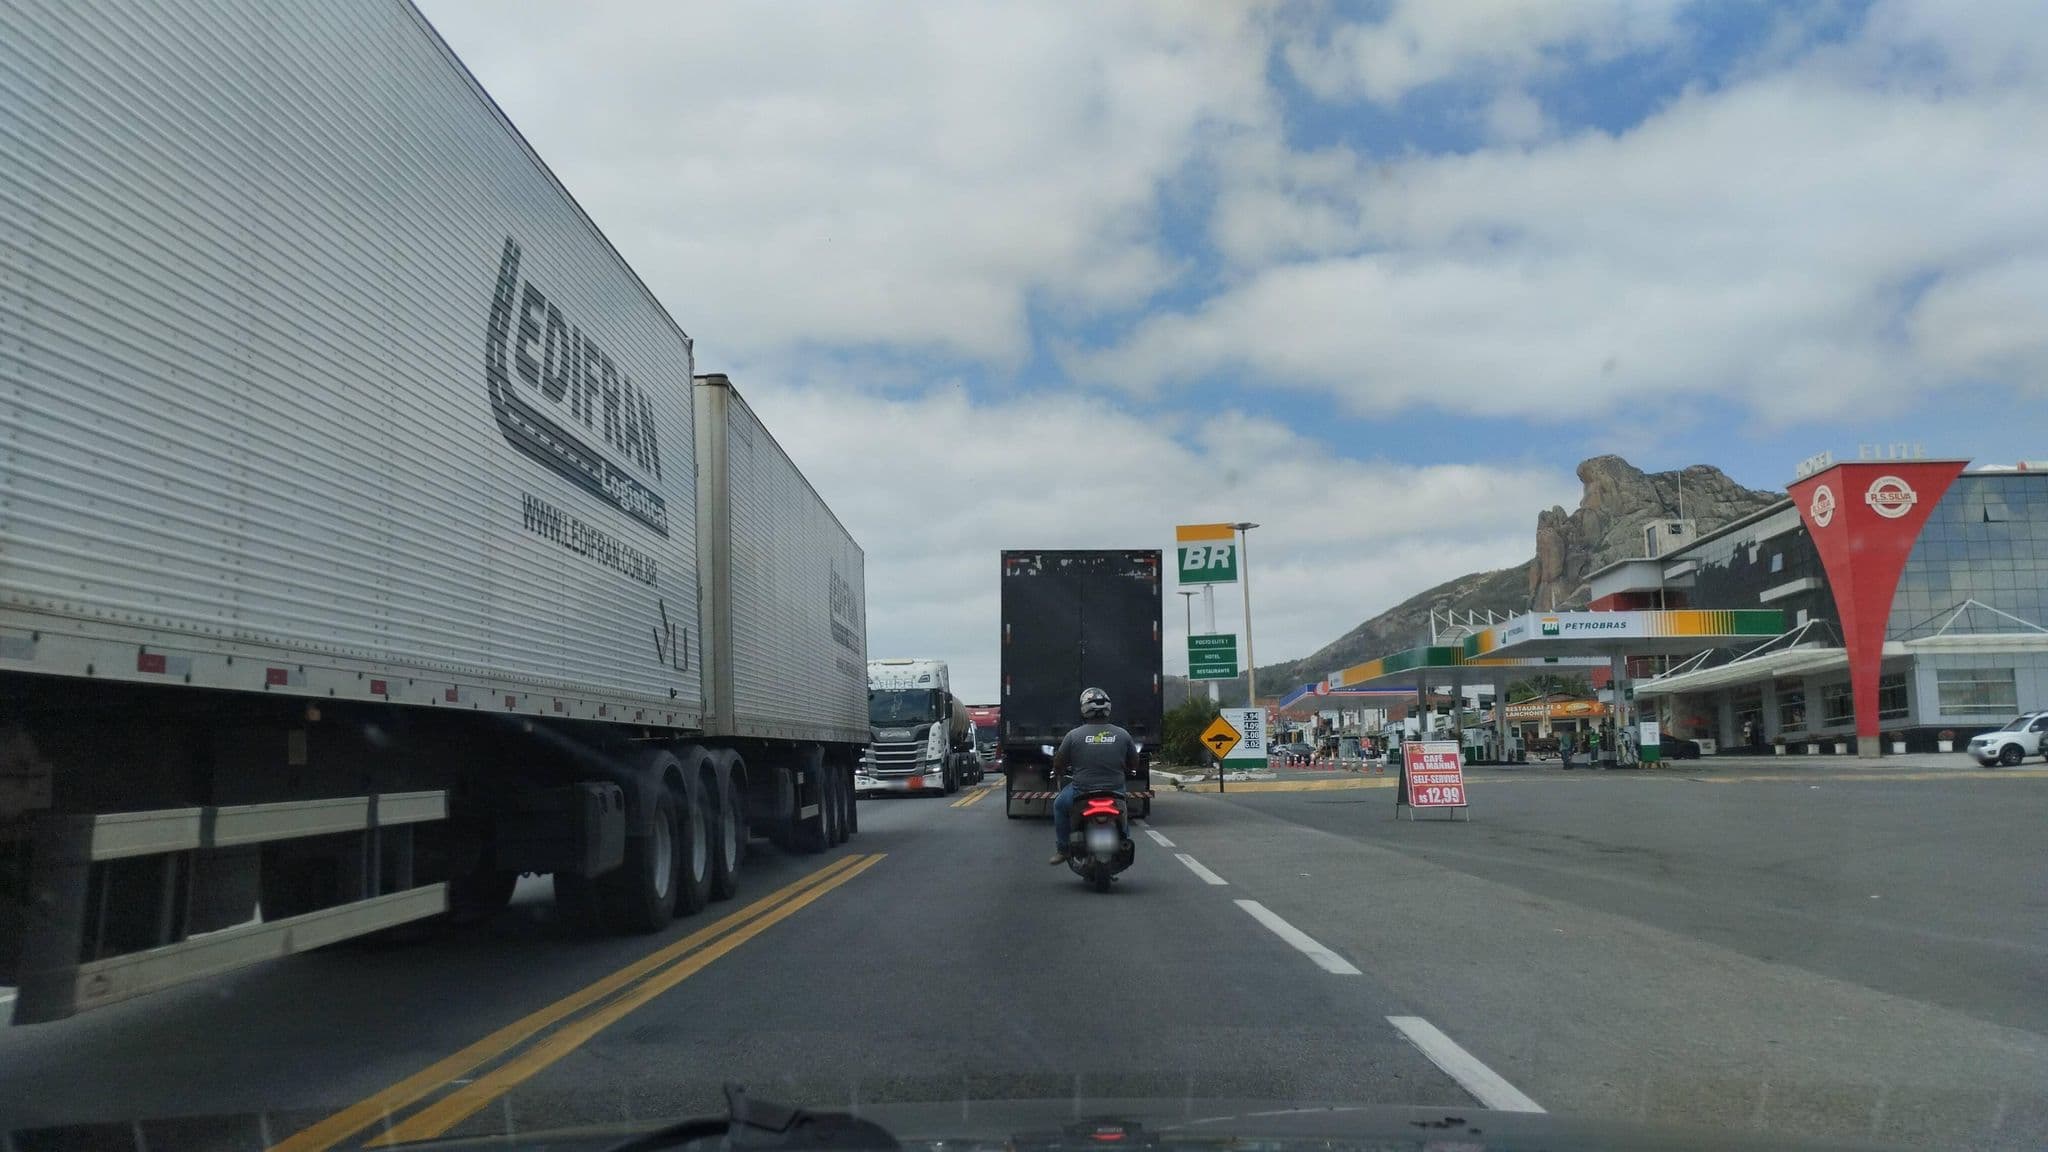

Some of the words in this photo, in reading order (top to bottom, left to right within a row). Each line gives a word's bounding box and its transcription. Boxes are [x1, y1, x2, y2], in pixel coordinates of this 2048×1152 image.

[484, 234, 666, 505] LEDIFRAN
[1182, 544, 1231, 570] BR
[1564, 621, 1627, 631] PETROBRAS
[1085, 733, 1118, 743] Global
[1413, 762, 1425, 770] DA
[1413, 774, 1460, 784] SELF-SERVICE
